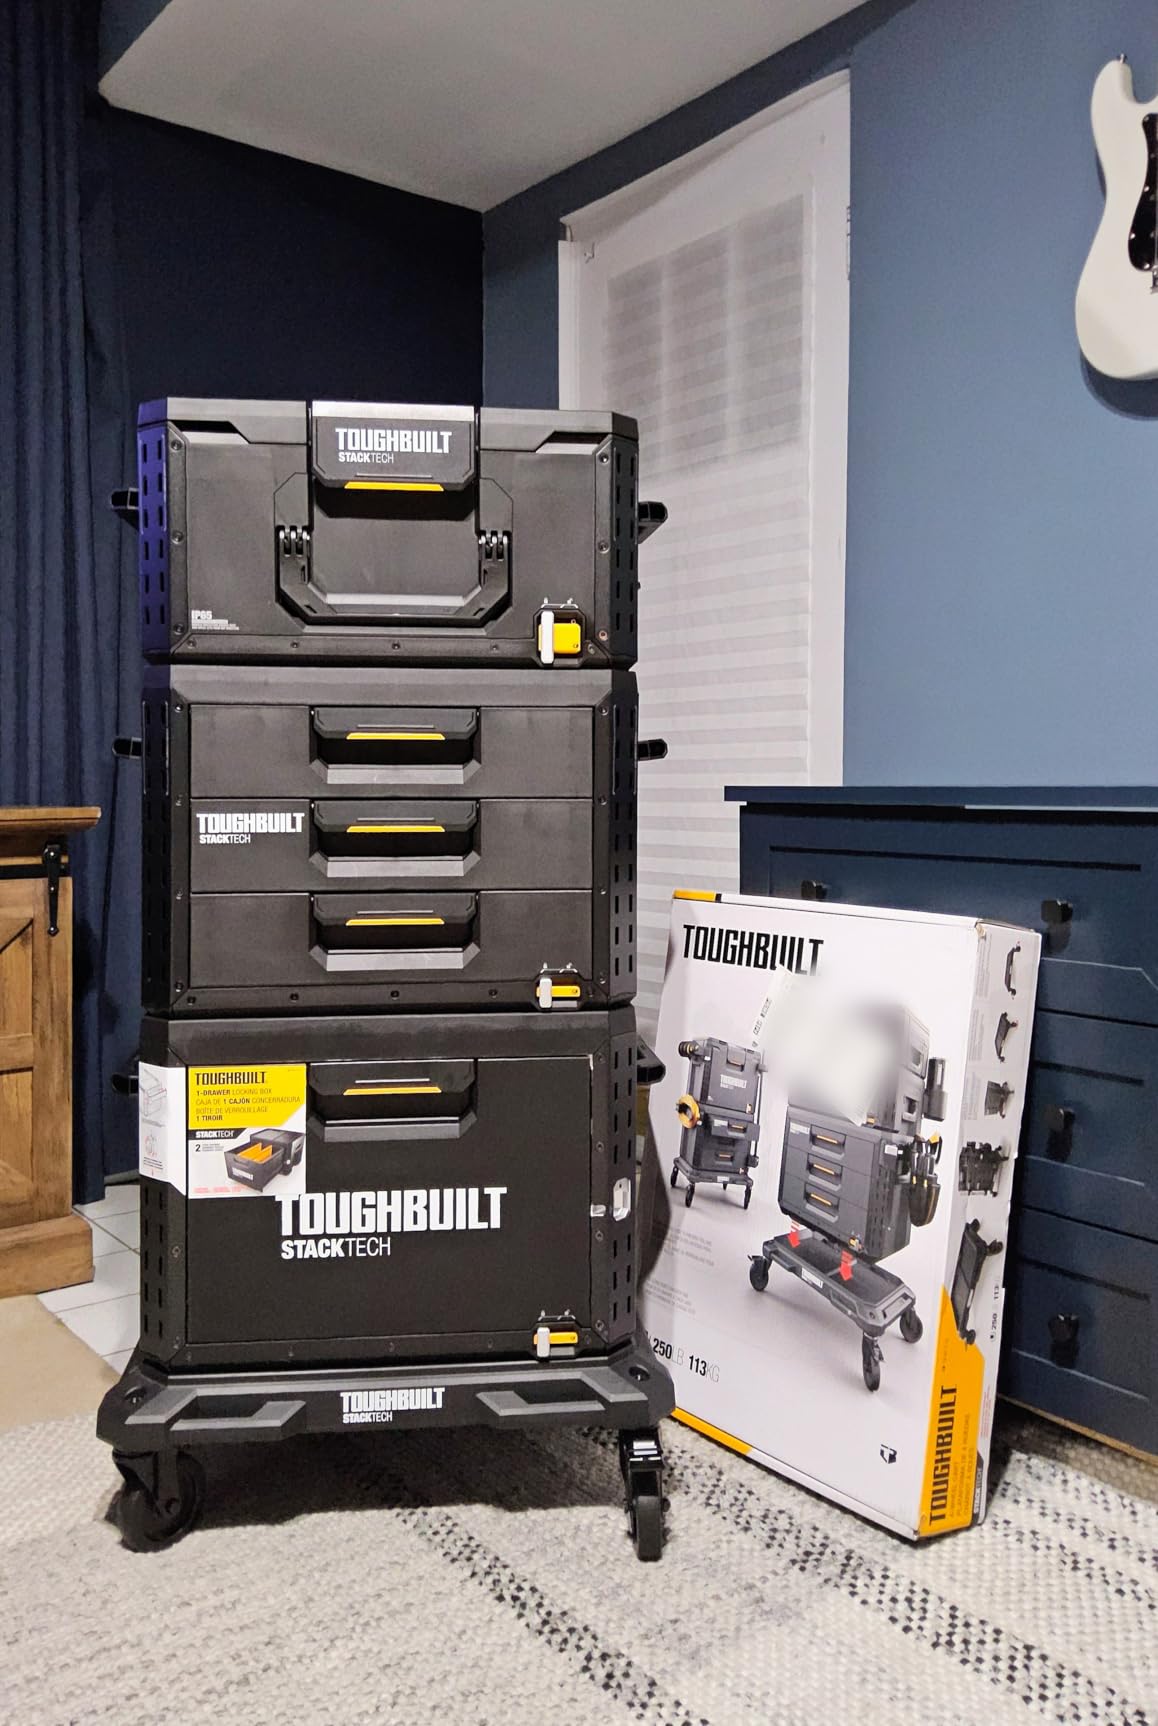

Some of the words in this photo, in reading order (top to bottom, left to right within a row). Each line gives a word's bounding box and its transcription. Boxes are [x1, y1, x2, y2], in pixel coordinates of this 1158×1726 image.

[335, 428, 453, 453] TOUGHBUILT
[338, 452, 394, 463] STACKTECH
[196, 812, 305, 834] TOUGHBUILT
[199, 834, 251, 844] STACKTECH
[683, 924, 825, 977] TOUGHBUILT
[195, 1071, 267, 1086] TOUGHBUILT
[196, 1089, 231, 1097] 1-DRAWER
[195, 1130, 234, 1139] STACKTECH
[195, 1144, 201, 1153] 2
[275, 1187, 507, 1236] TOUGHBUILT
[281, 1237, 391, 1260] STACKTECH
[340, 1387, 446, 1413] TOUGHBUILT
[343, 1411, 393, 1424] STACKTECH
[929, 1384, 957, 1526] TOUGHBUILT
